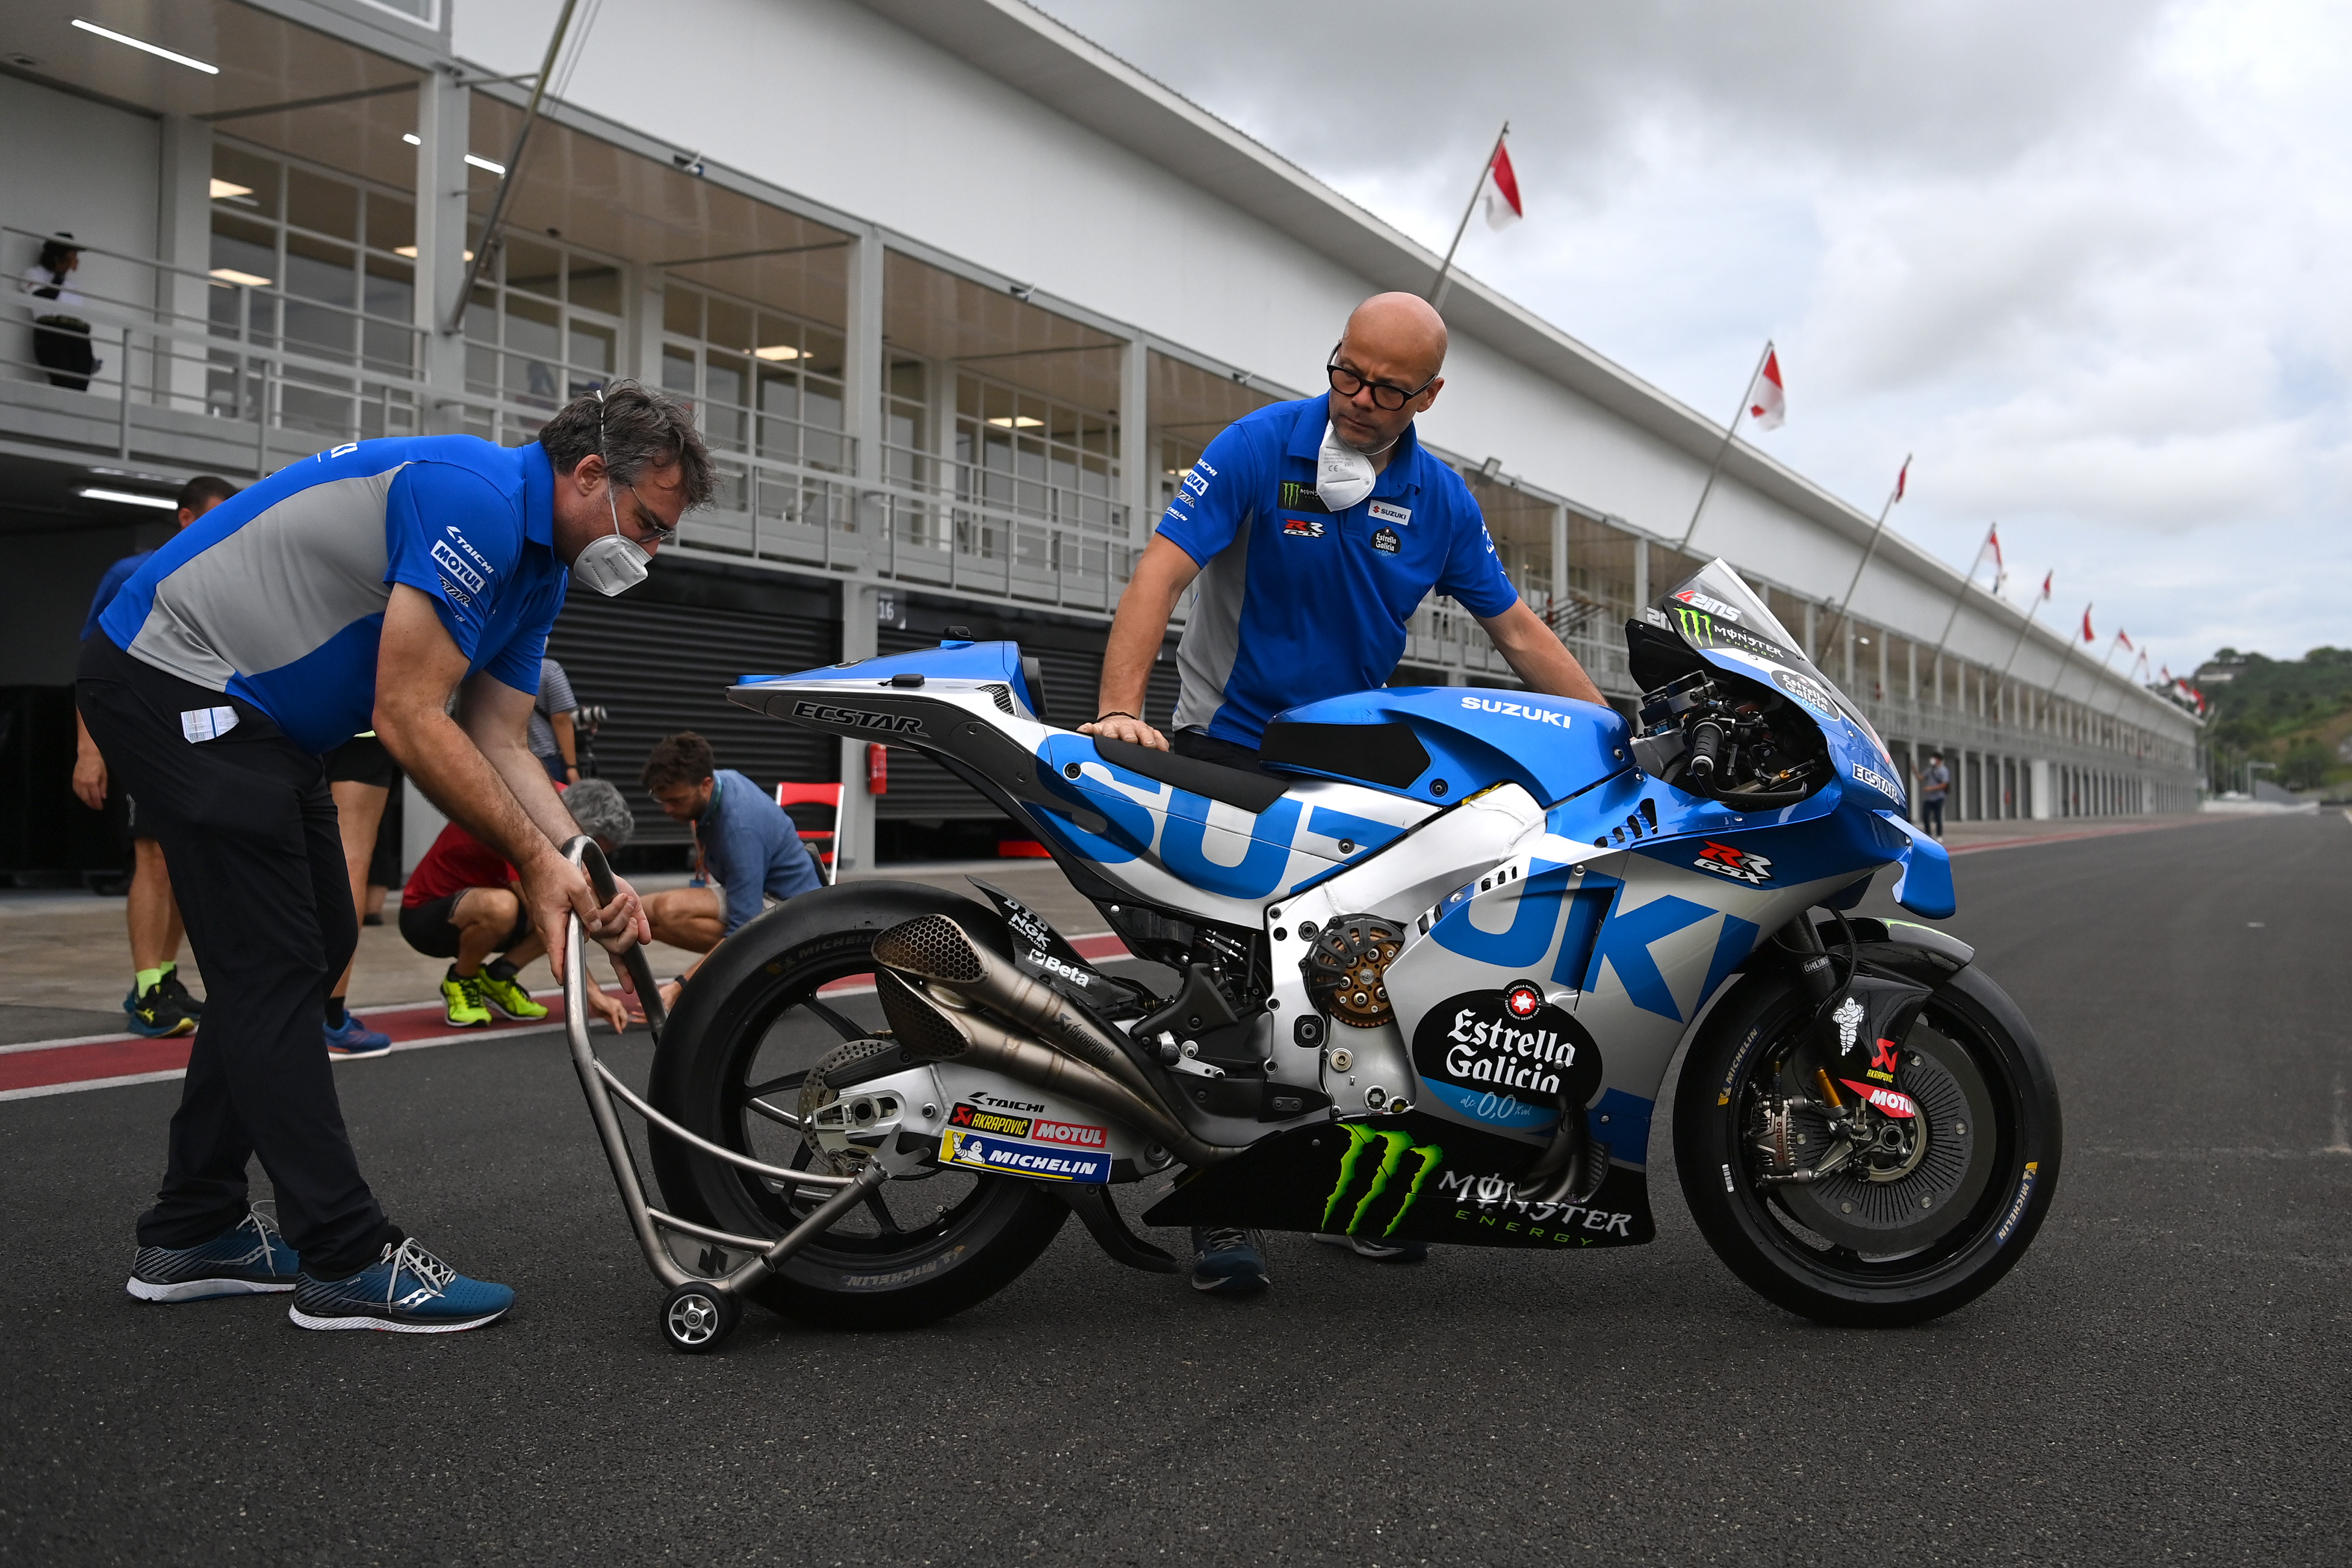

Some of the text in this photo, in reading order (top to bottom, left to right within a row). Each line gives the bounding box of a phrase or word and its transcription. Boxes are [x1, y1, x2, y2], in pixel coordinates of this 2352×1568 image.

[1300, 487, 1319, 497] MONS
[1381, 508, 1406, 520] SUZUKI
[1283, 529, 1324, 538] GSX
[1375, 532, 1397, 545] Estrella
[1375, 540, 1395, 552] Galicia
[434, 544, 482, 591] MOTUL
[457, 536, 495, 574] TAICHI
[439, 576, 471, 608] STAR
[878, 601, 894, 621] 16
[1713, 624, 1785, 658] MONSTER
[1726, 638, 1775, 658] ENERGY
[1782, 674, 1829, 706] Estrella
[1785, 682, 1829, 713] Galicia
[791, 700, 931, 738] ECSTAR
[1461, 696, 1571, 729] SUZUKI
[1852, 763, 1900, 806] ECSTAR
[1693, 858, 1769, 885] GSX
[1007, 920, 1046, 951] SPARK PLUGS
[1010, 912, 1051, 948] NGK
[1044, 955, 1090, 988] Beta
[1446, 1008, 1576, 1068] Estrella
[1446, 1044, 1561, 1094] Galicia
[1725, 1027, 1758, 1085] MICHELIN
[985, 1097, 1045, 1113] TAICHI
[1476, 1091, 1516, 1119] 0,0
[1035, 1122, 1102, 1145] MOTUL
[1776, 1121, 1785, 1161] brembo
[988, 1149, 1098, 1175] MICHELIN
[1438, 1170, 1632, 1237] MONSTER
[1998, 1182, 2030, 1240] MICHELIN
[1455, 1209, 1594, 1246] ENERGY
[846, 1260, 937, 1286] MICHELIN
